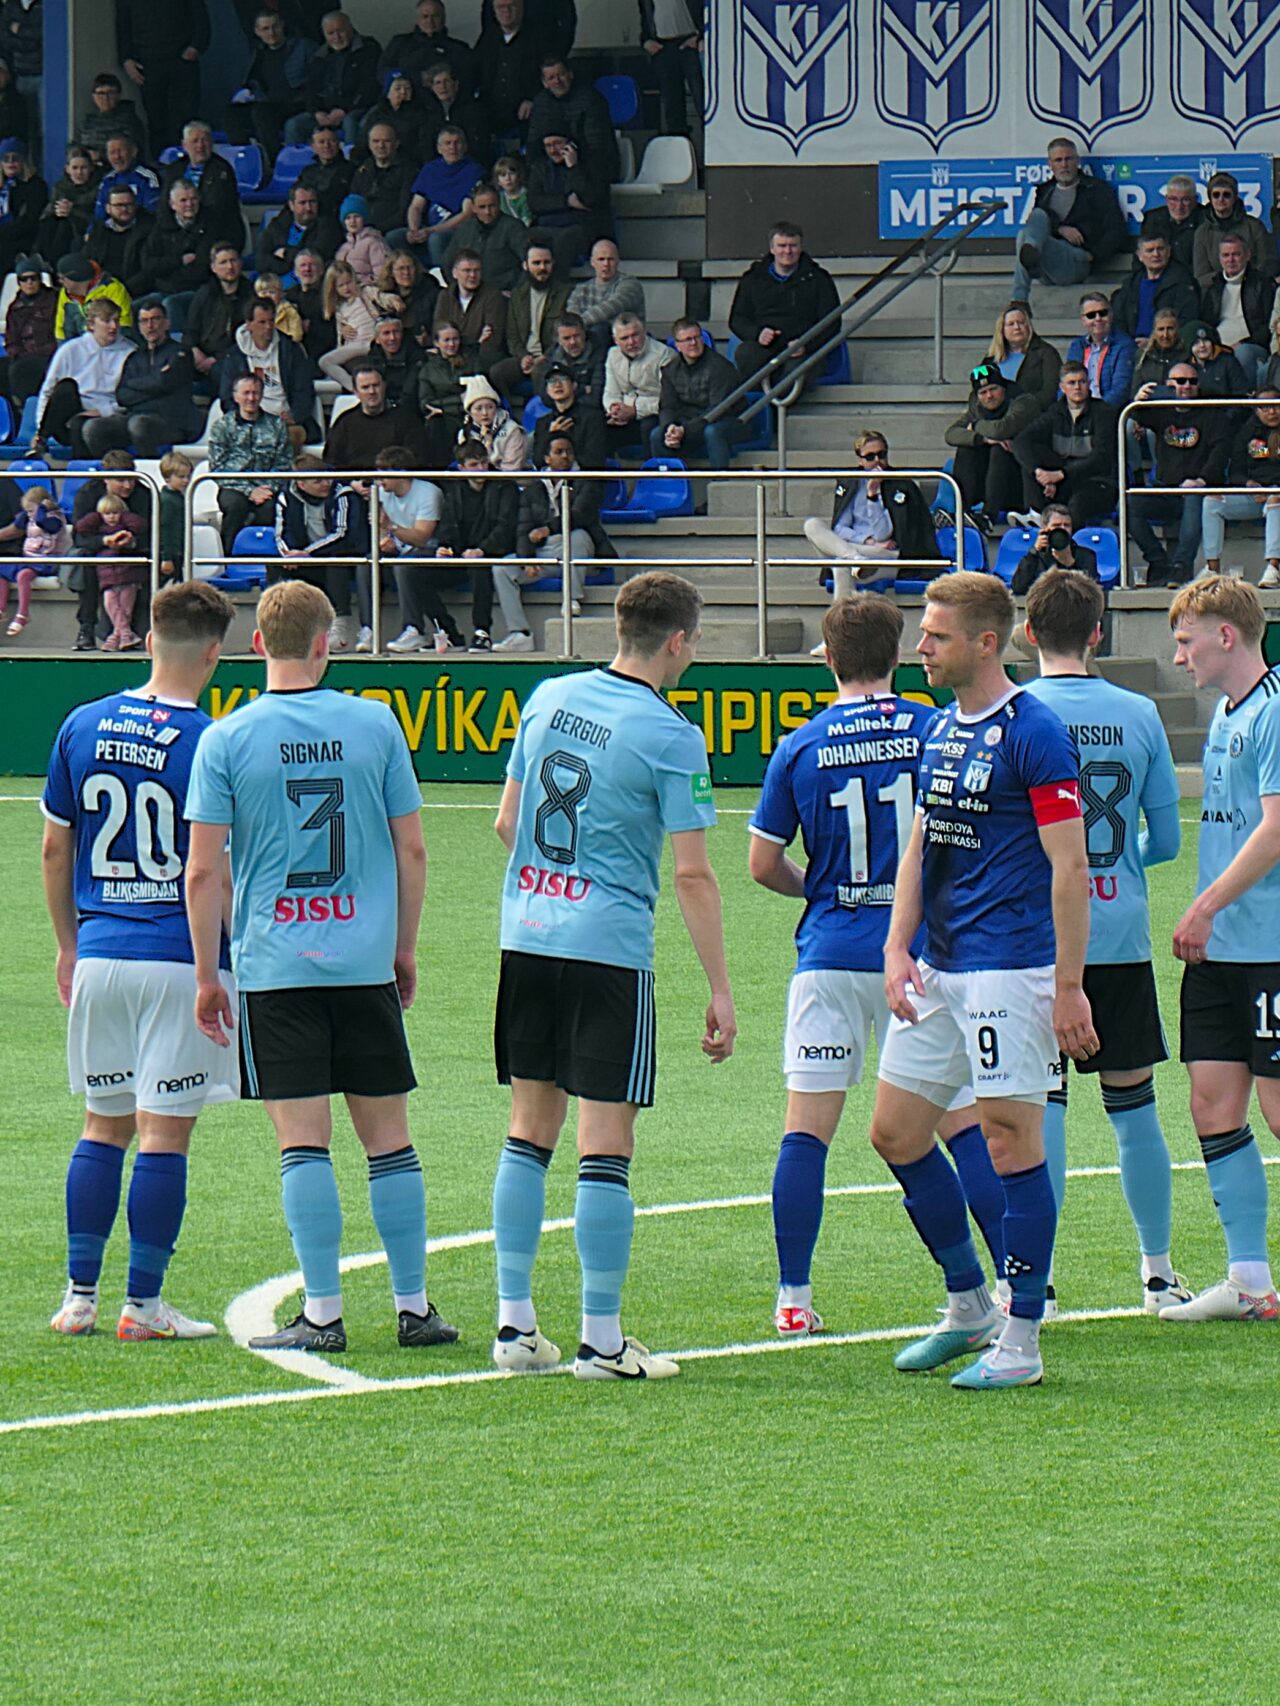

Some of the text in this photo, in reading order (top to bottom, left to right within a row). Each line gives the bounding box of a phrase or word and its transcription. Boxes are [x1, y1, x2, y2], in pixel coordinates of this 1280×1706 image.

[1015, 163, 1094, 184] FØRA
[118, 705, 152, 718] SPORT
[97, 718, 157, 739] Malltek
[550, 708, 613, 751] BERGUR
[828, 715, 893, 737] Malltek
[1066, 725, 1124, 747] NSSON
[95, 740, 167, 771] PETERSEN
[280, 741, 344, 765] SIGNAR
[931, 778, 954, 794] KBI
[534, 750, 593, 866] 8
[82, 773, 184, 882] 20
[285, 777, 345, 889] 3
[829, 772, 915, 883] 11
[517, 864, 593, 902] SISU
[274, 895, 357, 924] SISU
[968, 1010, 1008, 1020] WAAG
[798, 1045, 845, 1061] nema
[978, 1025, 1000, 1070] 9
[157, 1073, 205, 1094] nema
